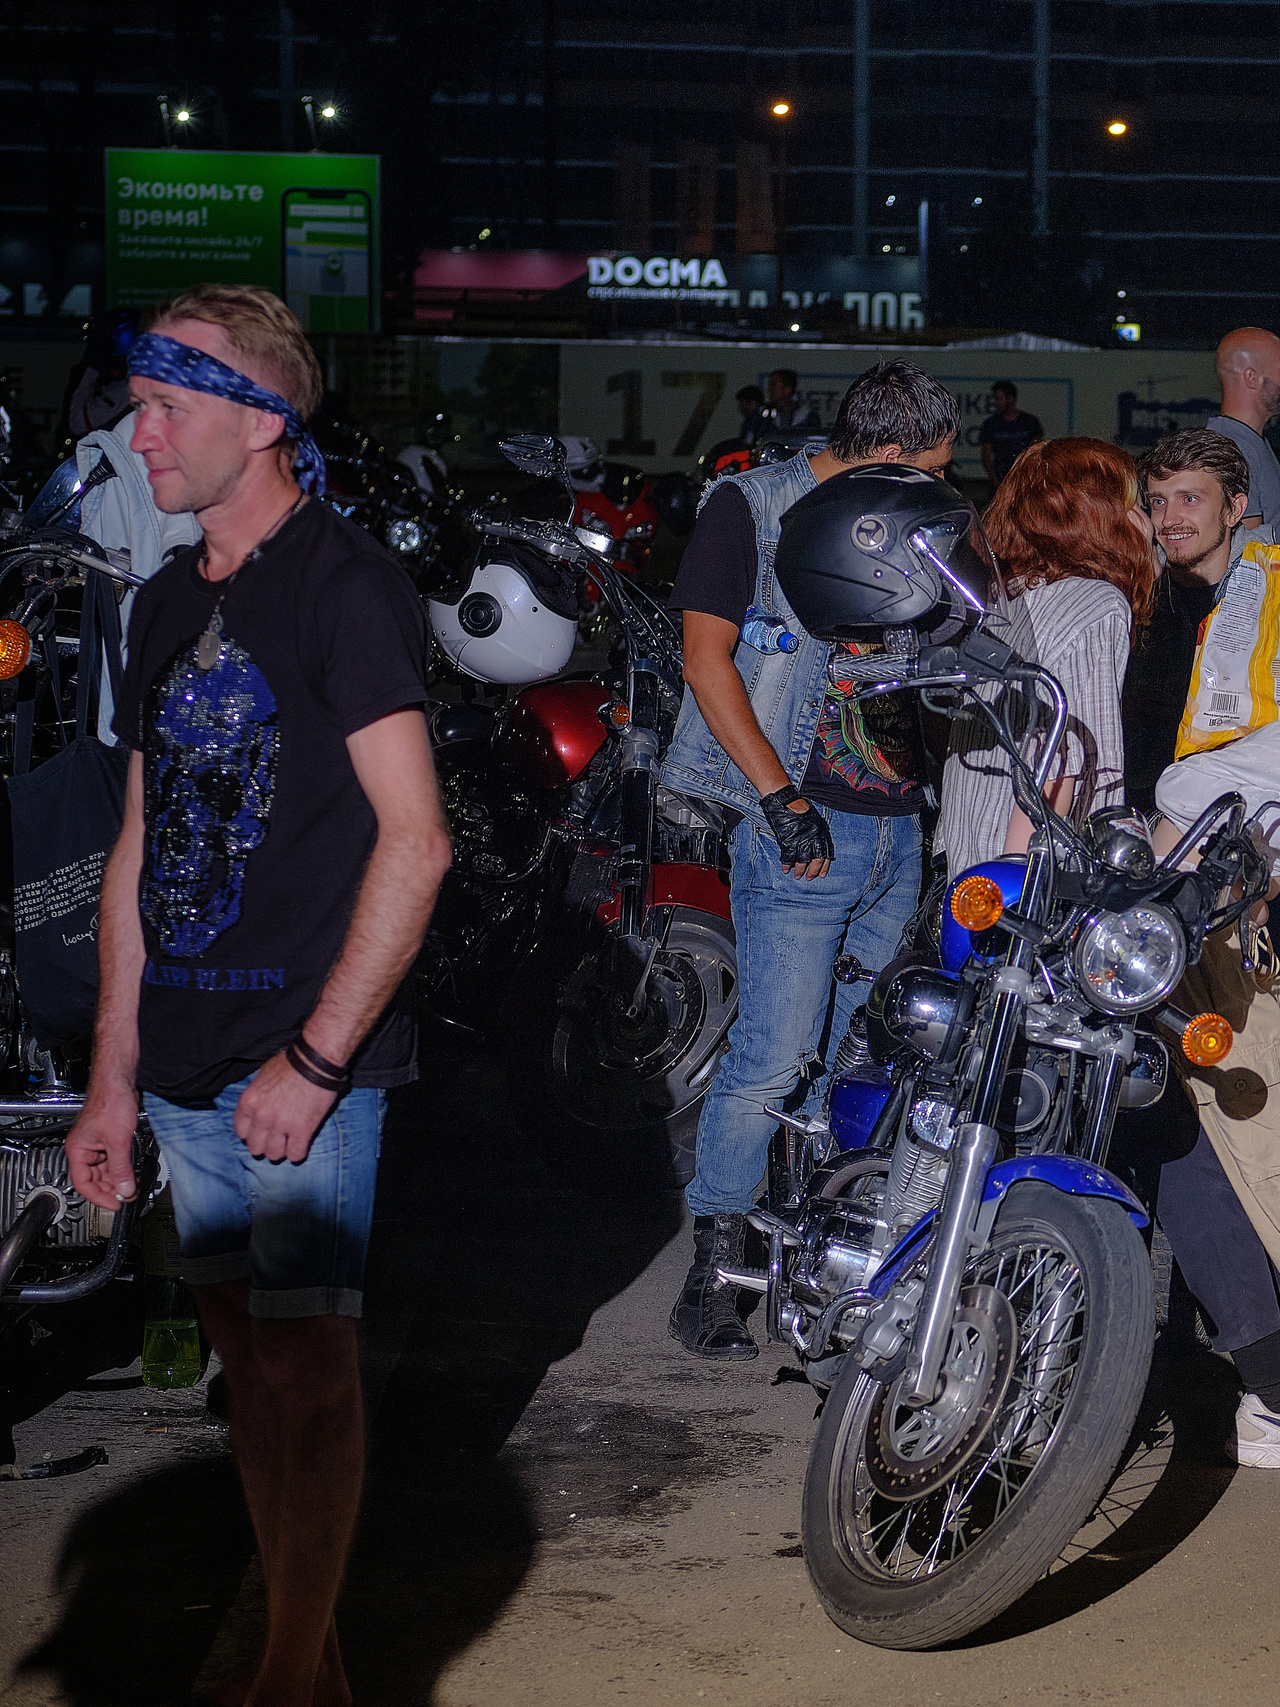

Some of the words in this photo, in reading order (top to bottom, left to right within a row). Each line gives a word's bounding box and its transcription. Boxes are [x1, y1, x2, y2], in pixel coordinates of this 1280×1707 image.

[118, 177, 264, 202] Экономьте
[118, 205, 208, 231] время!
[587, 256, 728, 287] DOGMA
[606, 370, 726, 455] 17
[53, 876, 67, 886] раз
[88, 868, 103, 877] как
[195, 967, 286, 991] PLEIN
